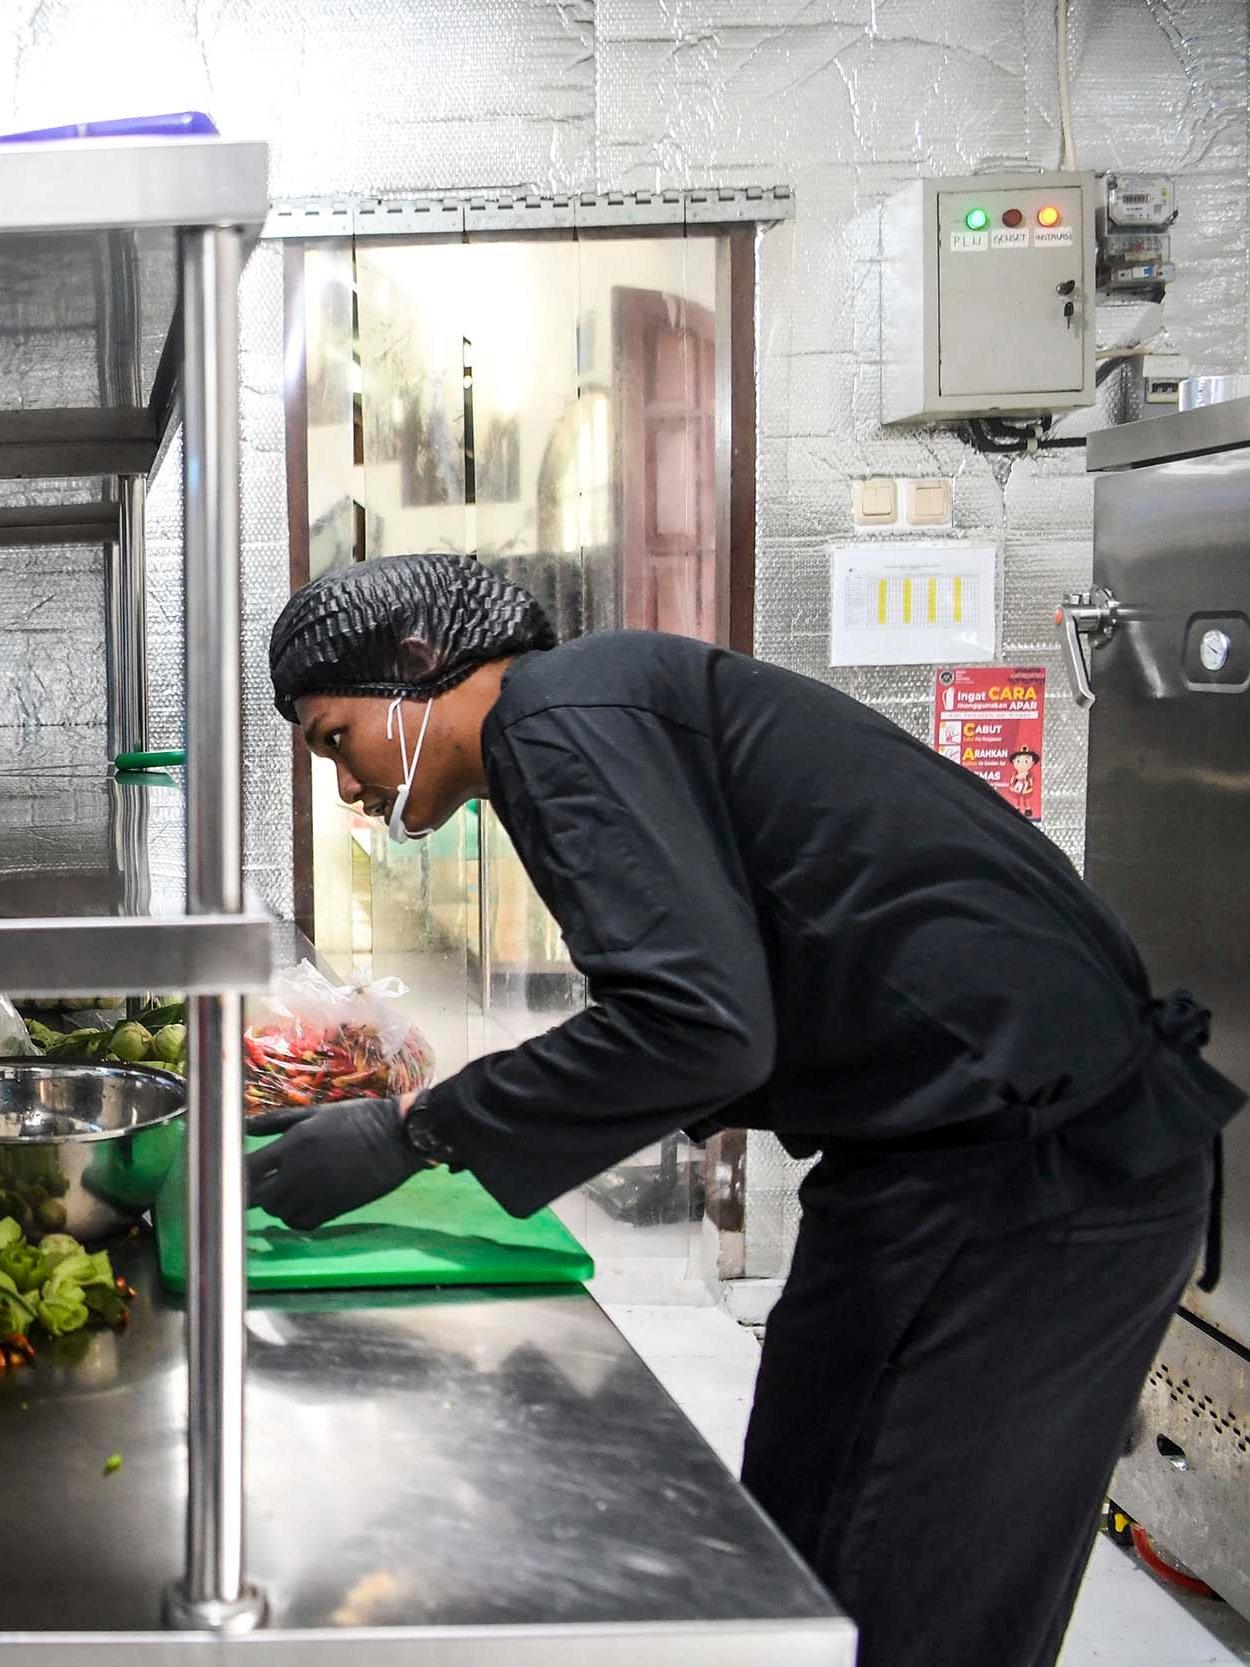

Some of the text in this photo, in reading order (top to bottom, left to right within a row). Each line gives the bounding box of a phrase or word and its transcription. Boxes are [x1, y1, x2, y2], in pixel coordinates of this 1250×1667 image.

[957, 686, 1037, 703] Ingat CARA
[957, 701, 1038, 711] menggunakan APAR
[963, 722, 1002, 737] CABUT
[961, 747, 1009, 761] ARAHKAN
